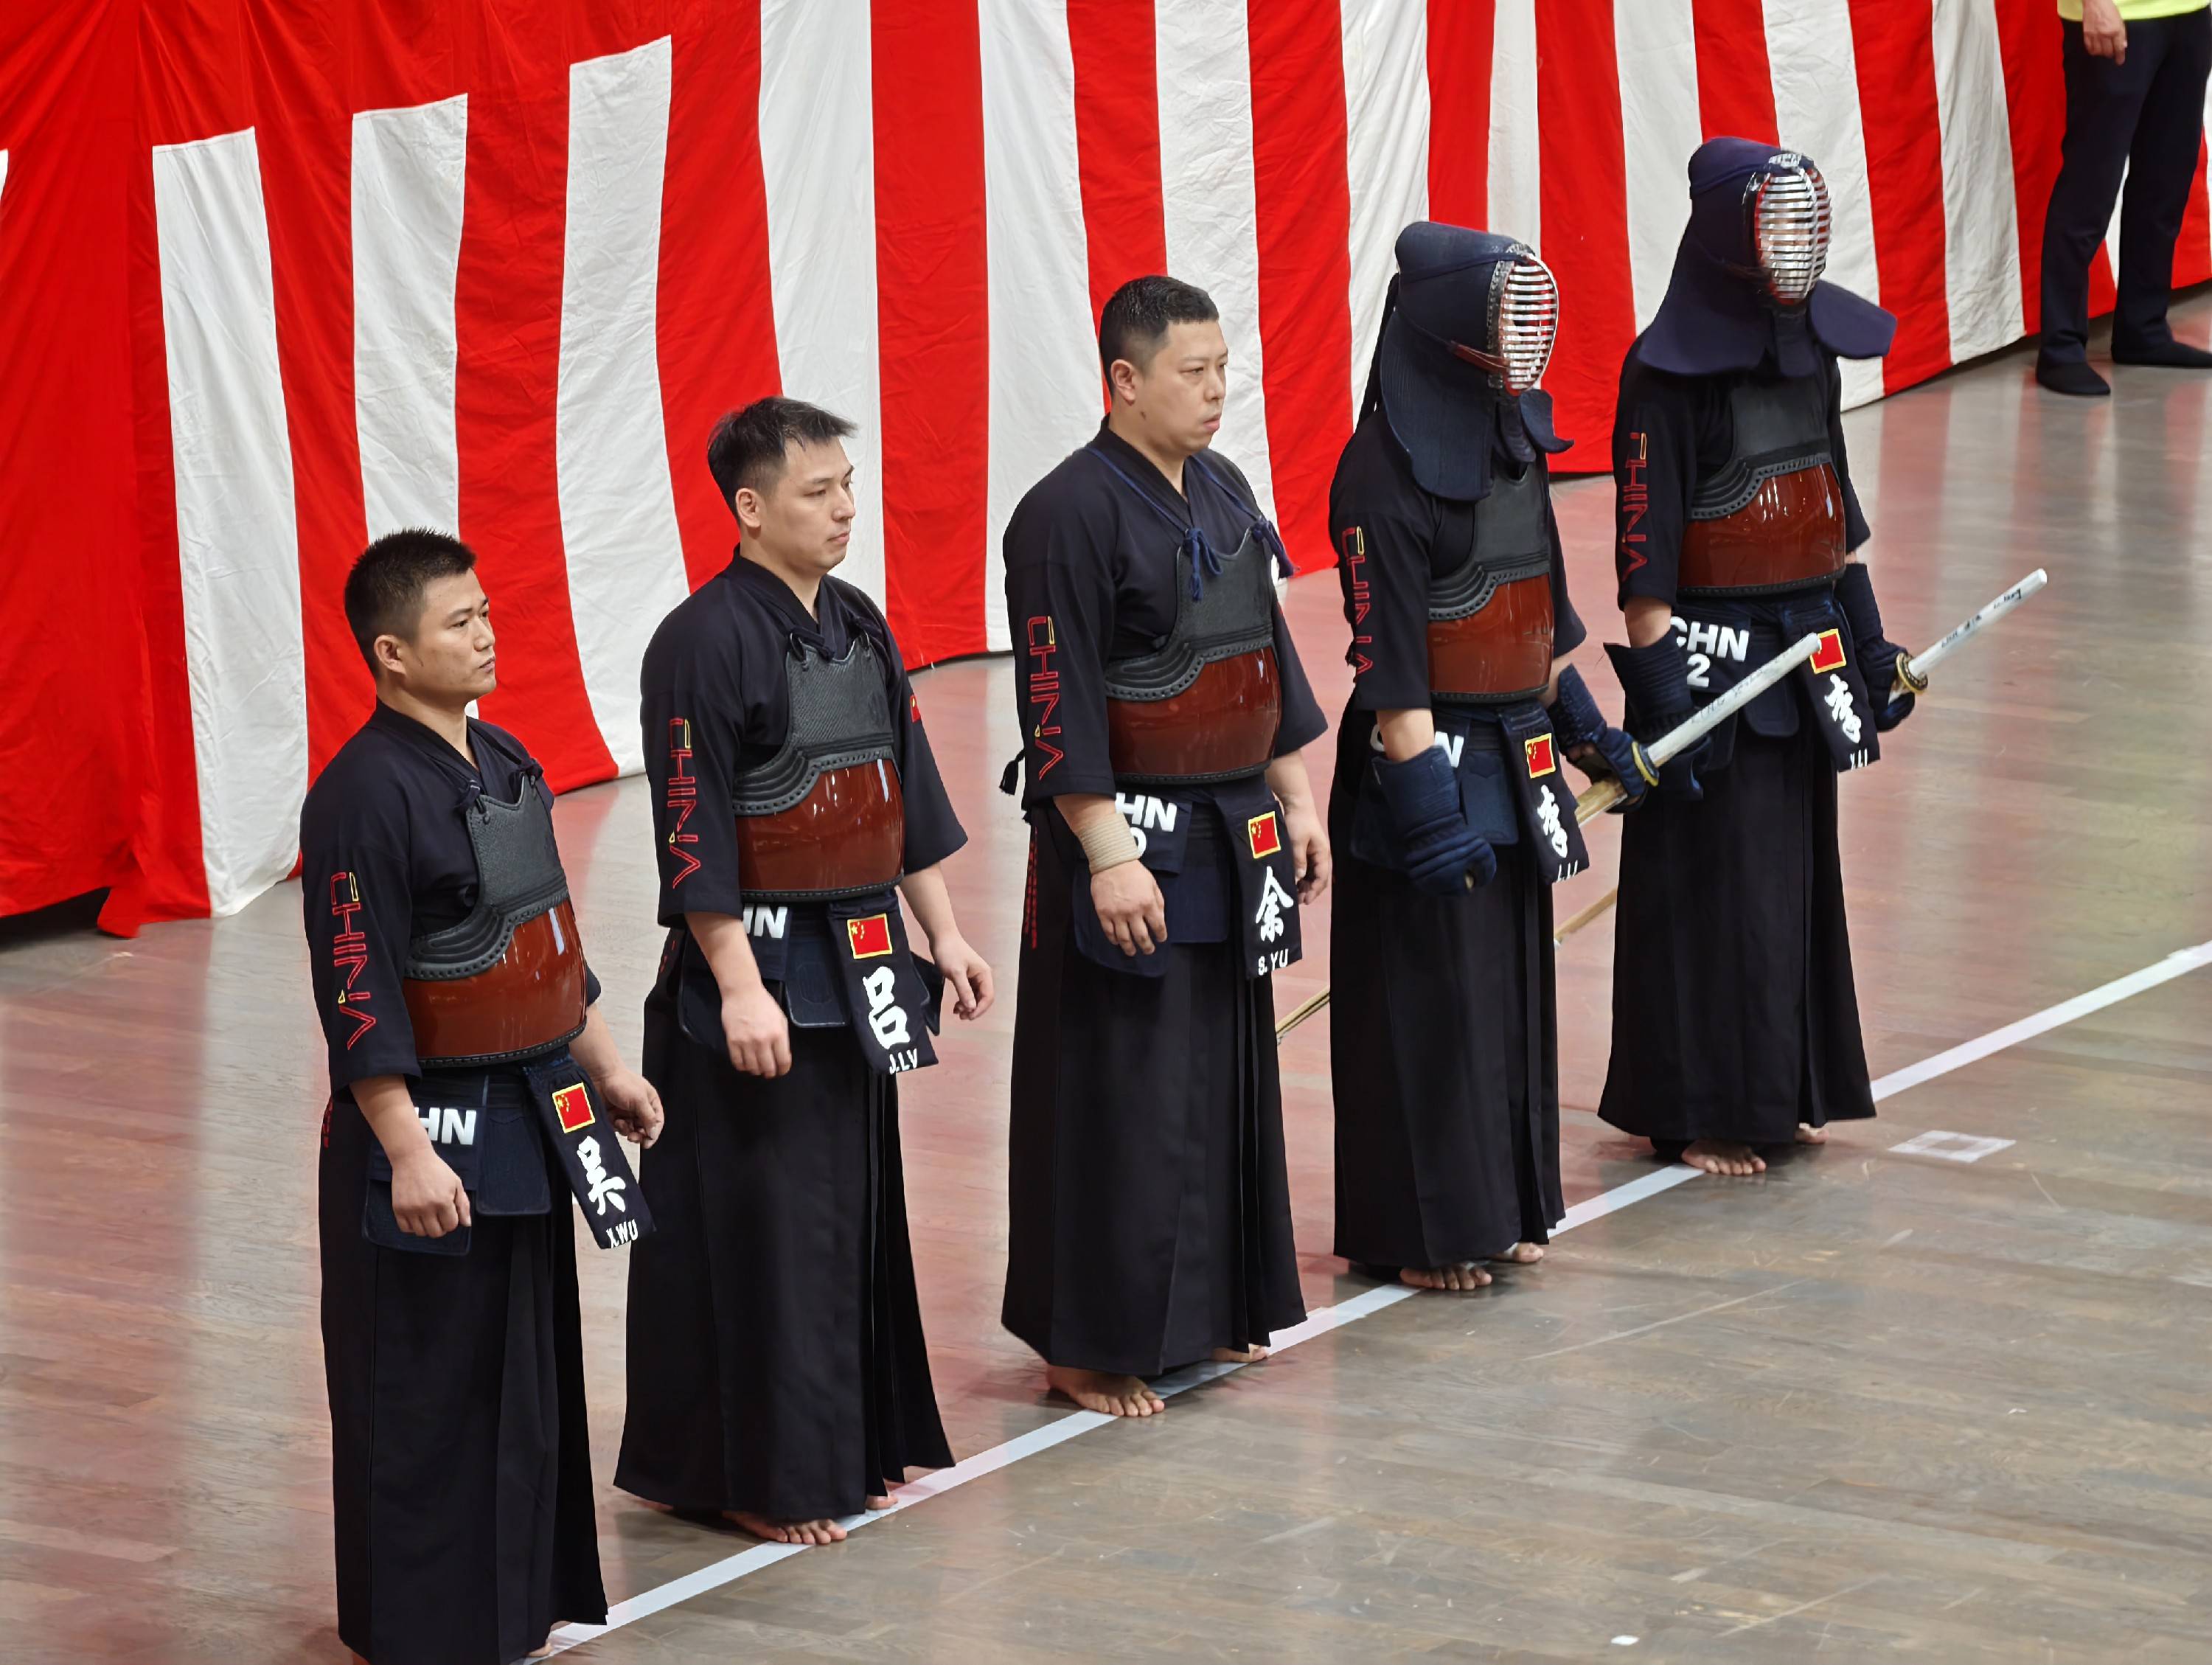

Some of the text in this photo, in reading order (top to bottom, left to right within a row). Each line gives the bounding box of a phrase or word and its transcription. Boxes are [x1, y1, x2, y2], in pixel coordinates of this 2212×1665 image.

[1026, 616, 1063, 781] CHINA
[1670, 616, 1750, 662] CHN
[1686, 653, 1711, 687] 2
[667, 716, 701, 889] CHINA
[330, 872, 376, 1051] CHINA
